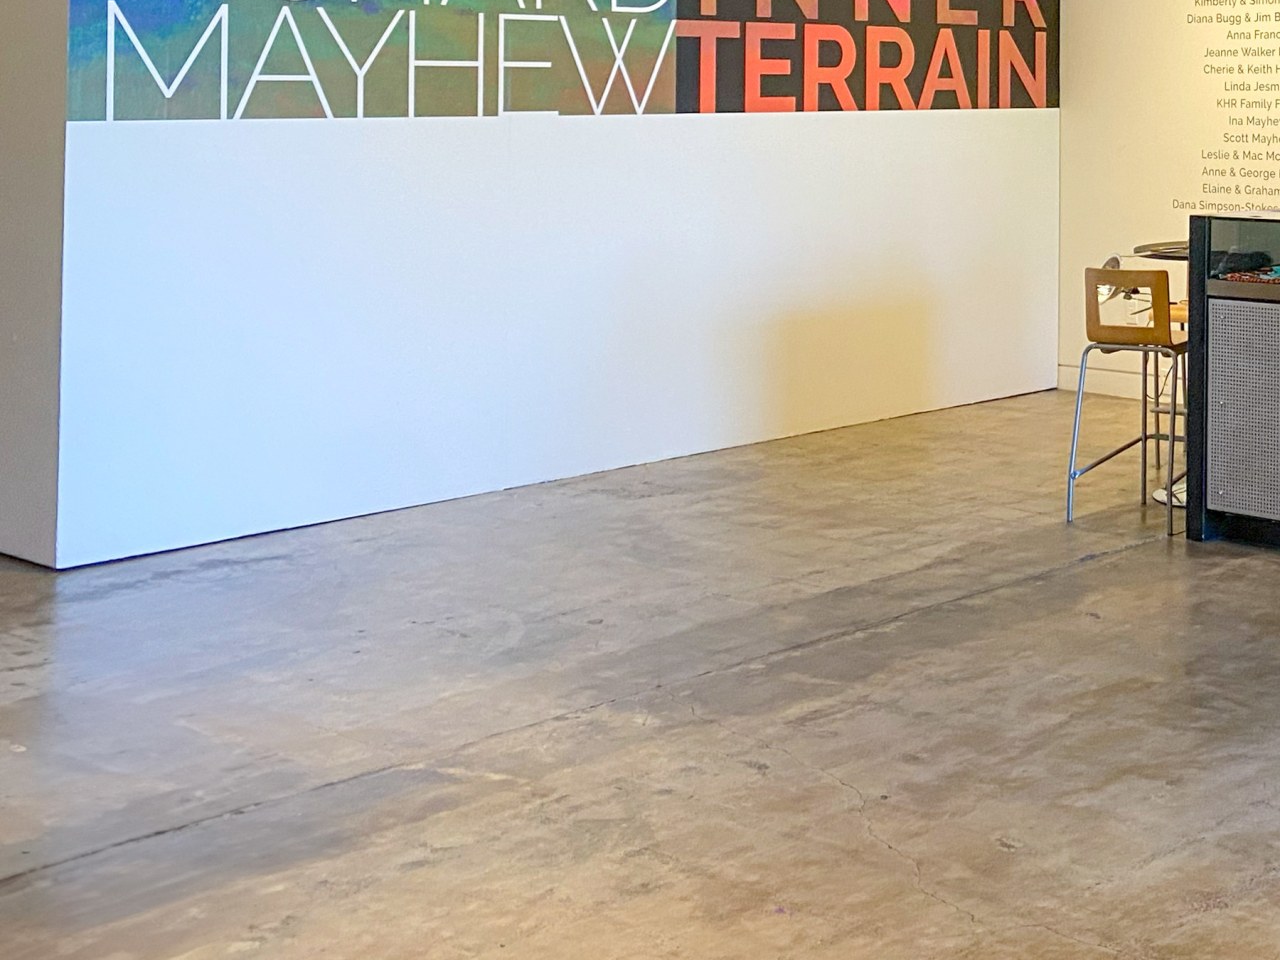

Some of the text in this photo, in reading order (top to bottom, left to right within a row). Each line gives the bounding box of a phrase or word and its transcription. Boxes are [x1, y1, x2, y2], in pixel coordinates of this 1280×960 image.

[1186, 13, 1214, 24] Diana
[1215, 12, 1242, 26] Bugg
[1244, 12, 1252, 23] &
[1253, 12, 1272, 23] Jim
[1226, 29, 1252, 40] Anna
[1203, 47, 1239, 58] Jeanne
[1240, 46, 1276, 57] Walker
[106, 0, 677, 120] MAYHEW
[676, 19, 1047, 113] TERRAIN
[1203, 63, 1235, 75] Cherie
[1237, 63, 1245, 75] &
[1247, 63, 1273, 75] Keith
[1224, 80, 1252, 92] Linda
[1216, 98, 1238, 109] KHR
[1240, 98, 1273, 112] Family
[1228, 115, 1244, 126] Ina
[1223, 132, 1249, 144] Scott
[1201, 149, 1231, 161] Leslie
[1232, 149, 1240, 161] &
[1242, 149, 1264, 161] Mac
[1201, 166, 1227, 177] Anne
[1229, 166, 1237, 178] &
[1238, 167, 1277, 182] George
[1202, 182, 1232, 195] Elaine
[1234, 184, 1242, 195] &
[1172, 198, 1197, 210] Dana
